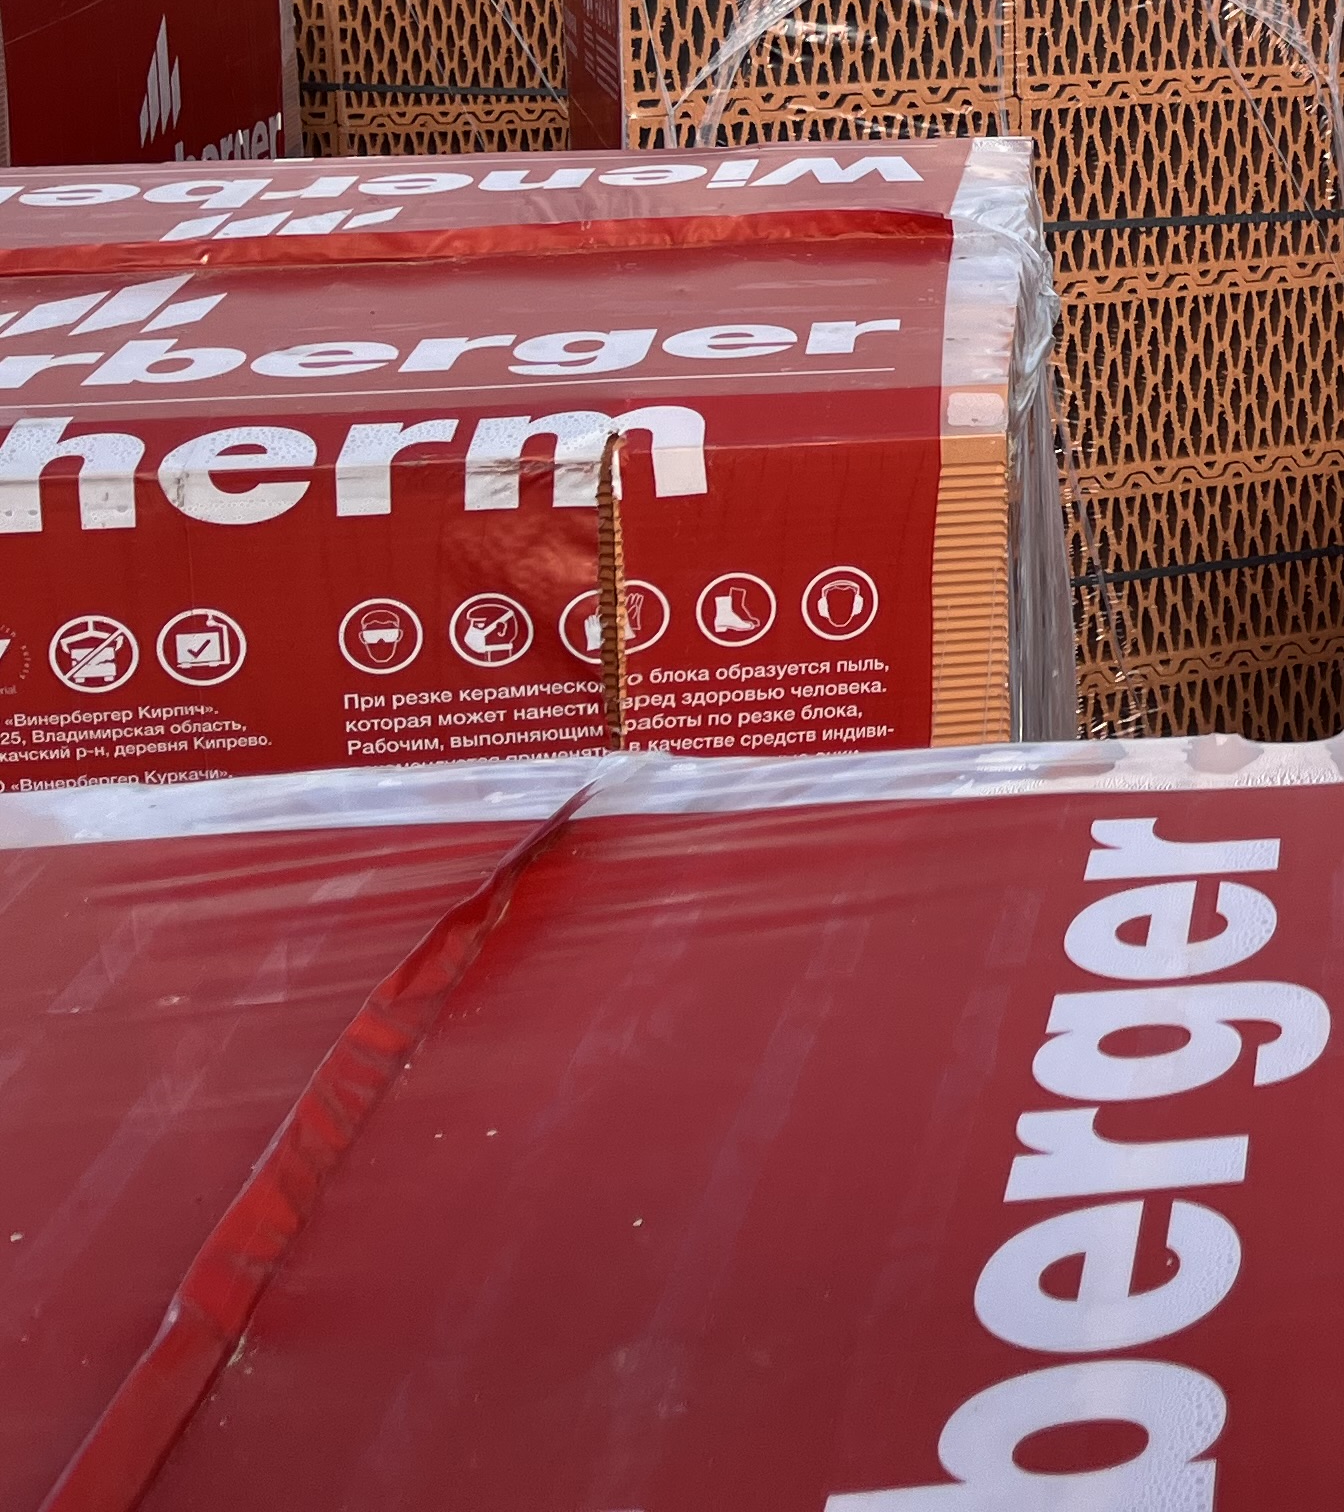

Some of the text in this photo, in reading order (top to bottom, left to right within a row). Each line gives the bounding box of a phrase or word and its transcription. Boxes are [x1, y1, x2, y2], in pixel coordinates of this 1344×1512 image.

[343, 692, 385, 712] При
[392, 688, 452, 709] резке
[650, 663, 710, 685] блока
[715, 659, 830, 681] образуется
[836, 657, 890, 673] пыль,
[5, 705, 219, 727] «Винербергер Кирпич».
[345, 716, 432, 734] которая
[438, 710, 508, 727] может
[513, 701, 599, 722] нанести
[681, 683, 785, 707] здоровью
[790, 678, 887, 698] человека.
[32, 724, 165, 743] Владимирская
[170, 719, 247, 734] область,
[347, 702, 863, 757] Рабочим, выполняющим работы по резке блока,
[647, 735, 735, 753] качестве
[740, 728, 816, 748] средств
[822, 725, 895, 743] индиви-
[76, 745, 110, 761] р-н,
[114, 740, 188, 758] деревня
[194, 734, 272, 751] Кипрево.
